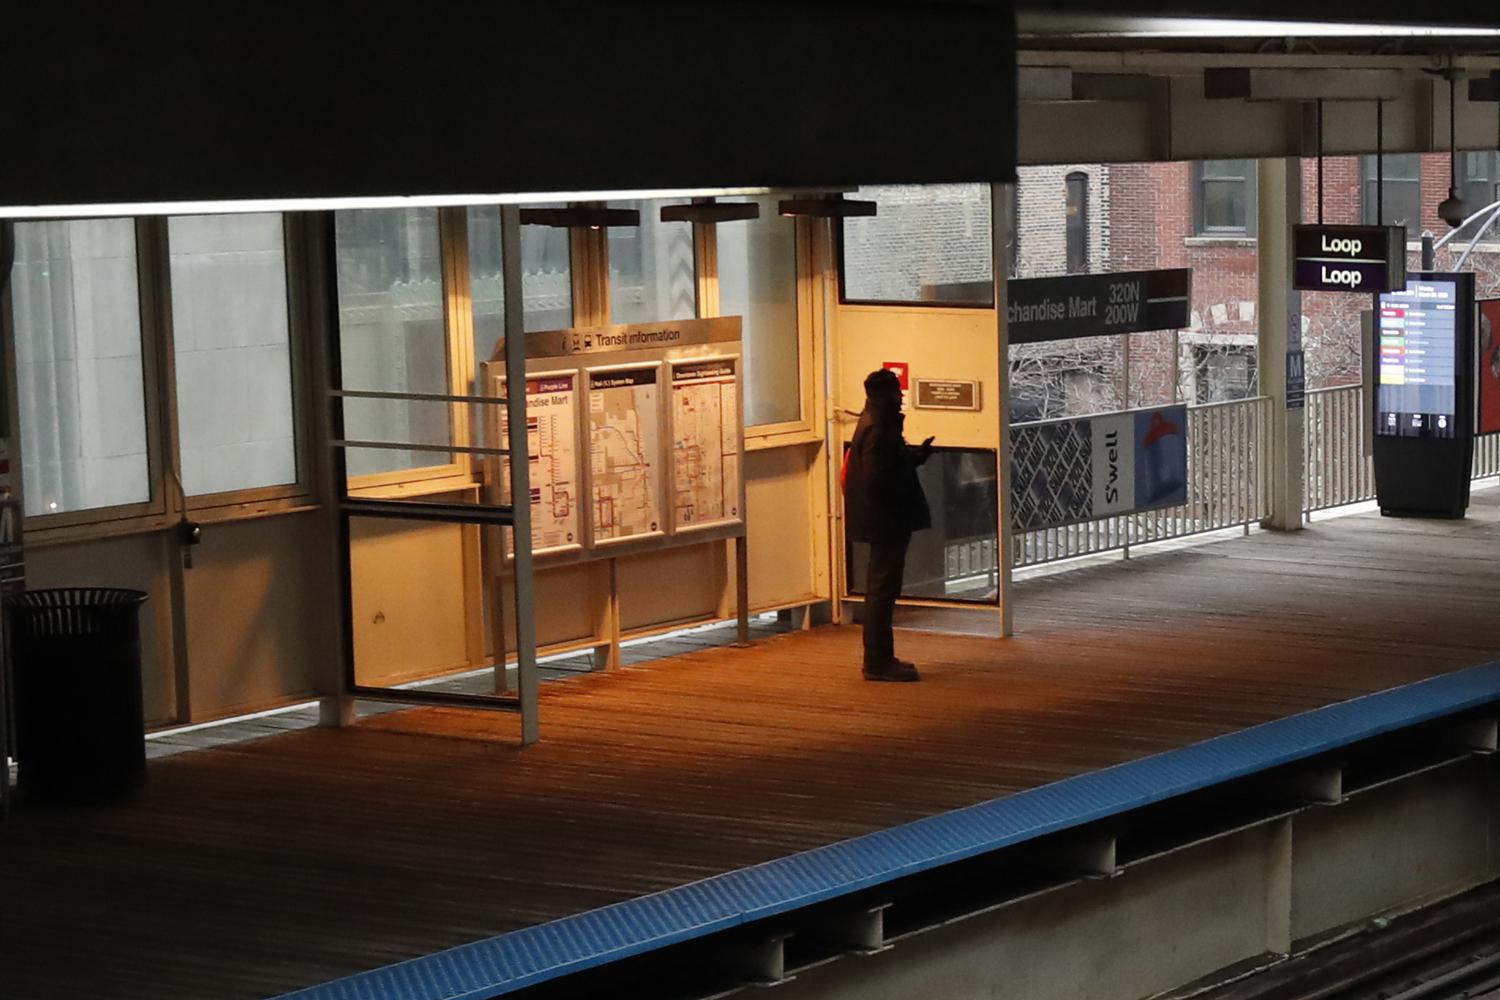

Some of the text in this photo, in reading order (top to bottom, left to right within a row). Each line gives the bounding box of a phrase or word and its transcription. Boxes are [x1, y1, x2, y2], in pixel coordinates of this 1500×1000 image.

[1321, 234, 1362, 256] Loop
[1321, 266, 1362, 288] Loop
[1108, 282, 1140, 303] 320N
[1068, 296, 1097, 318] Mart
[1105, 303, 1140, 325] 200W
[595, 333, 628, 347] Transit
[551, 395, 568, 406] Mart
[1105, 429, 1118, 504] S'well
